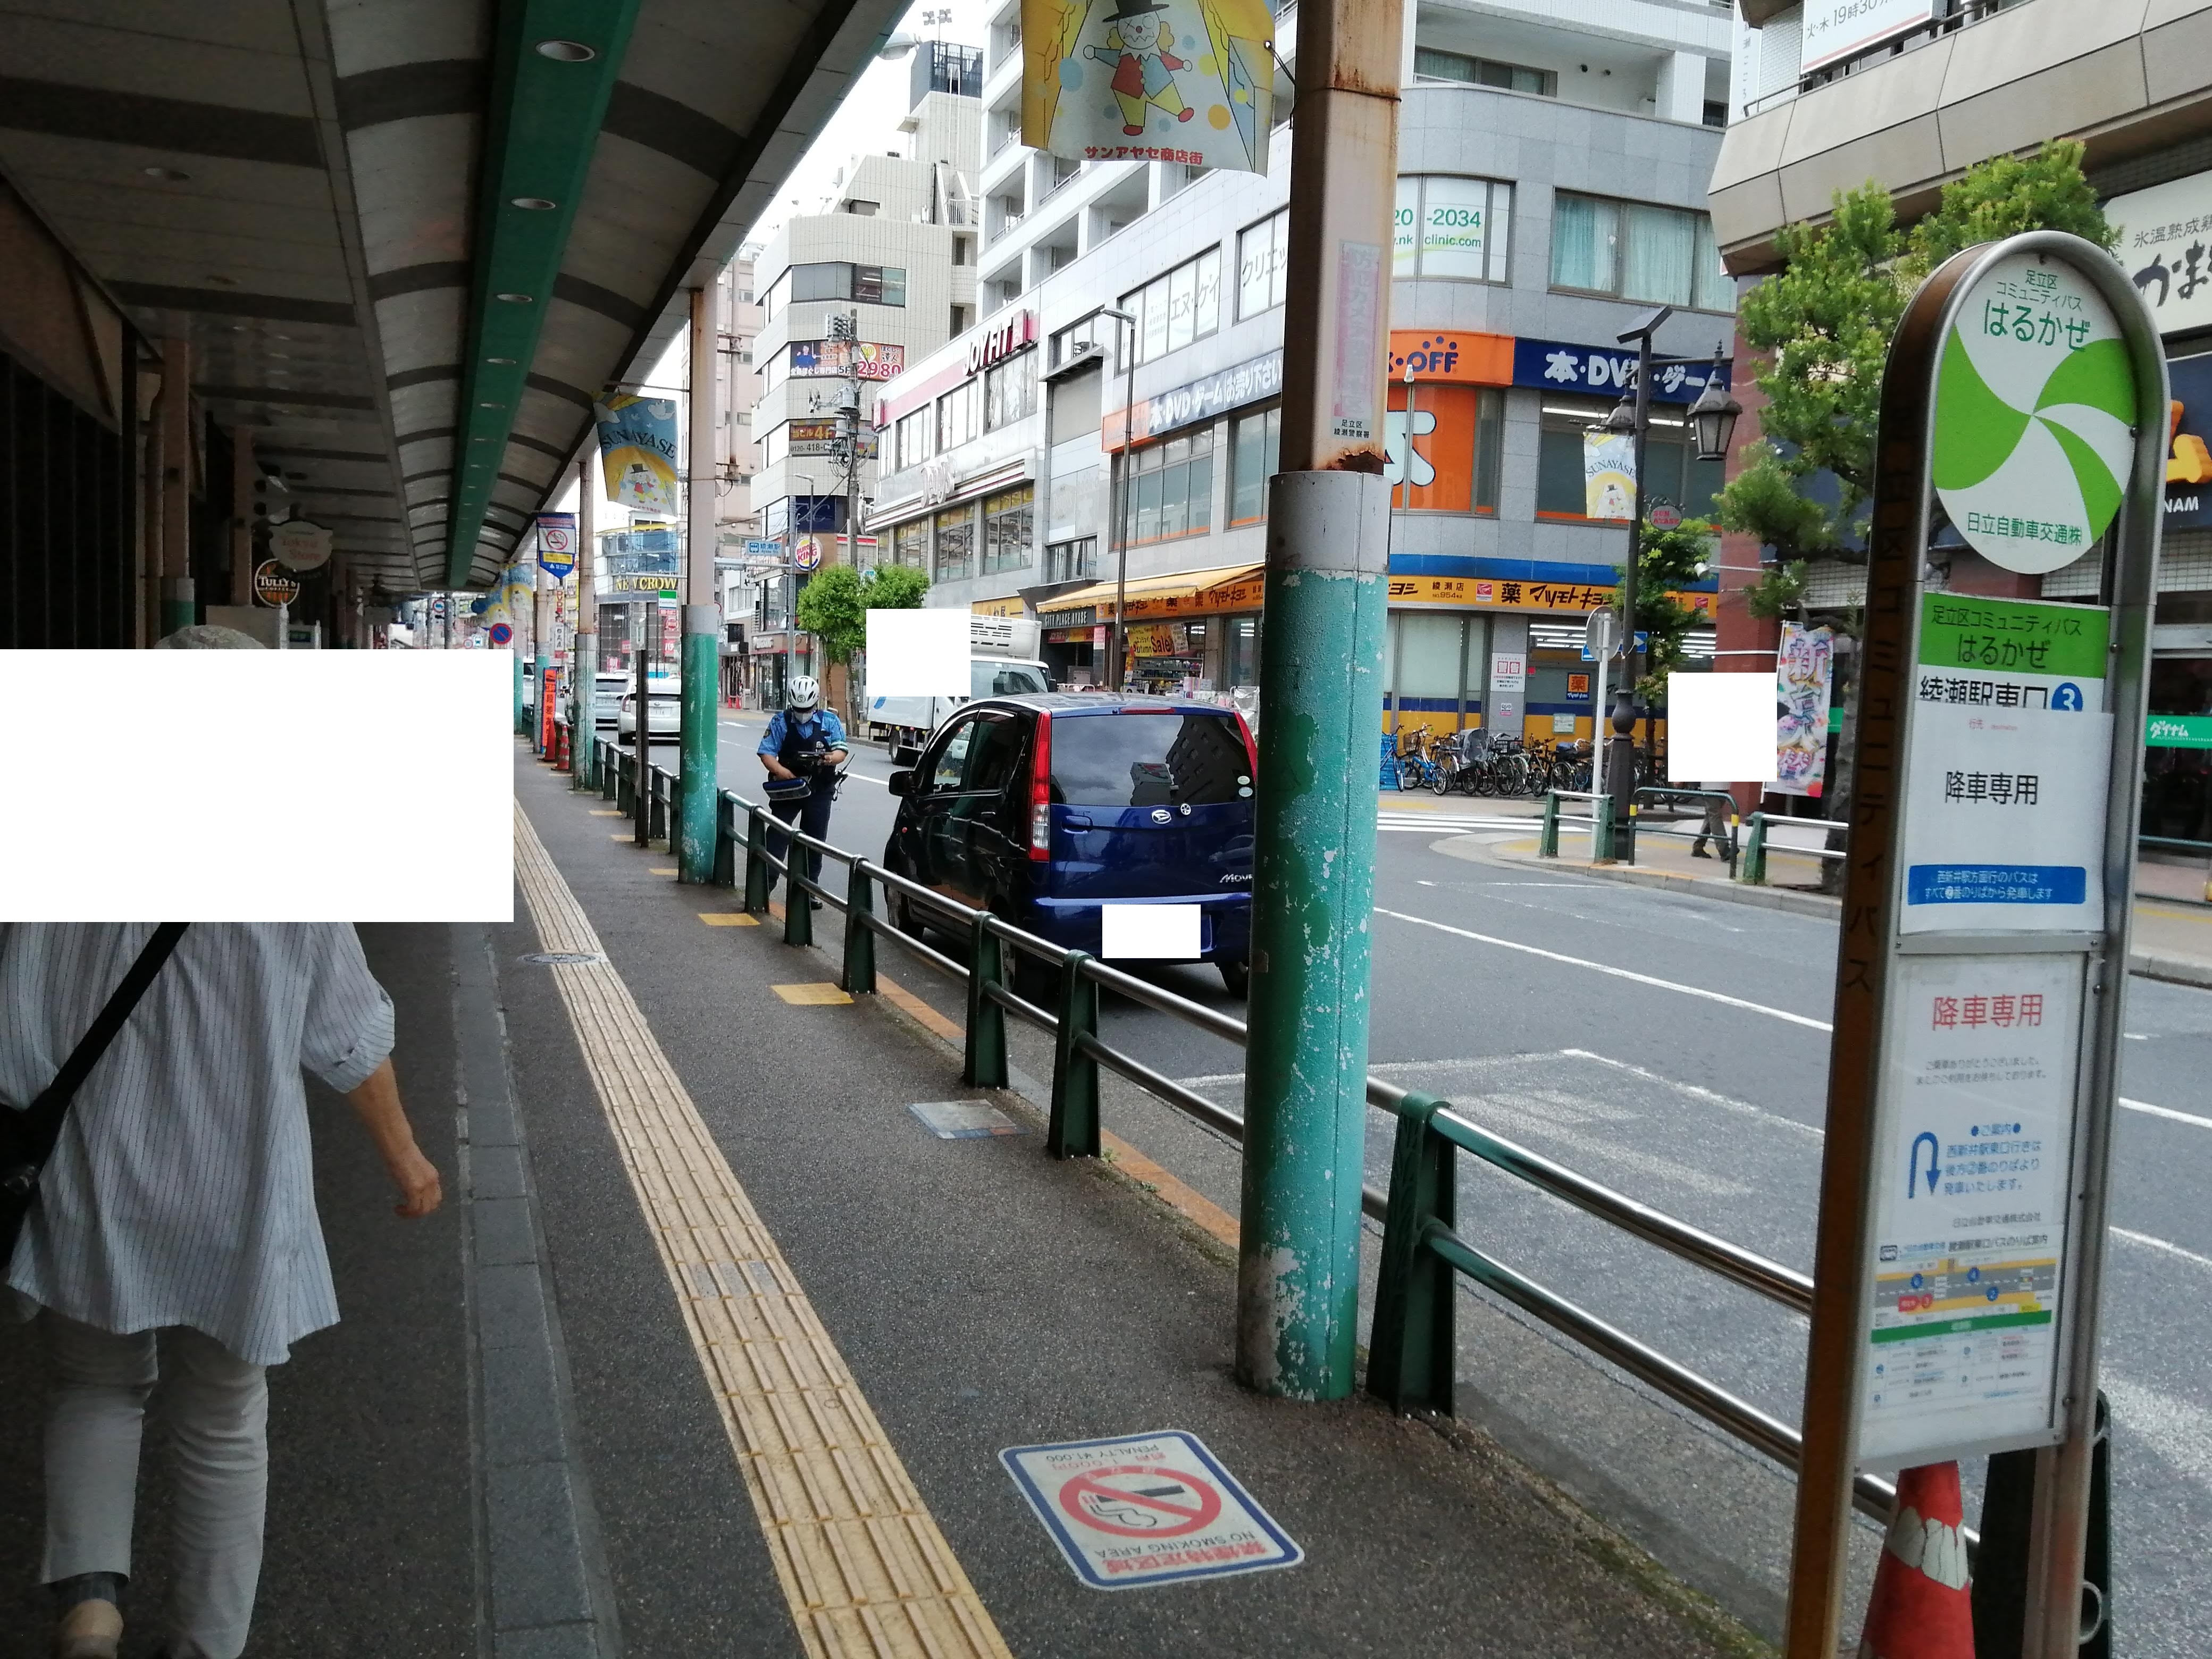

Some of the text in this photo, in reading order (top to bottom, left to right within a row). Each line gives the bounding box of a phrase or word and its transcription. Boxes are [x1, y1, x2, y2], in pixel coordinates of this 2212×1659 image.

[1084, 145, 1203, 165] サンアヤセ商店街
[2025, 269, 2058, 288] 足立区
[2132, 239, 2212, 307] かま
[1997, 281, 2083, 312] コミュニティバス
[1983, 299, 2091, 352] はるかぜ
[1341, 419, 1363, 429] 足立区
[601, 429, 678, 459] SUNAYASE
[1586, 458, 1636, 478] SUNAYASE
[2164, 496, 2199, 513] NAM
[639, 577, 677, 590] CROW
[1388, 583, 1419, 596] ヨシ
[1432, 581, 1464, 592] 綾瀬店
[1501, 583, 1522, 604] 薬
[1045, 614, 1055, 627] CITY
[1071, 611, 1087, 625] AYASE
[1931, 605, 2082, 636] 足立区コミュニティバス
[1150, 635, 1173, 653] Sale
[1957, 633, 2050, 669] はるかぜ
[1920, 675, 2048, 709] 綾瀬駅東口
[1945, 770, 2039, 805] 降車専用
[1932, 994, 2043, 1031] 降車専用
[1100, 1444, 1159, 1459] PENALTY
[1093, 1530, 1254, 1558] NO SMOKING AREA
